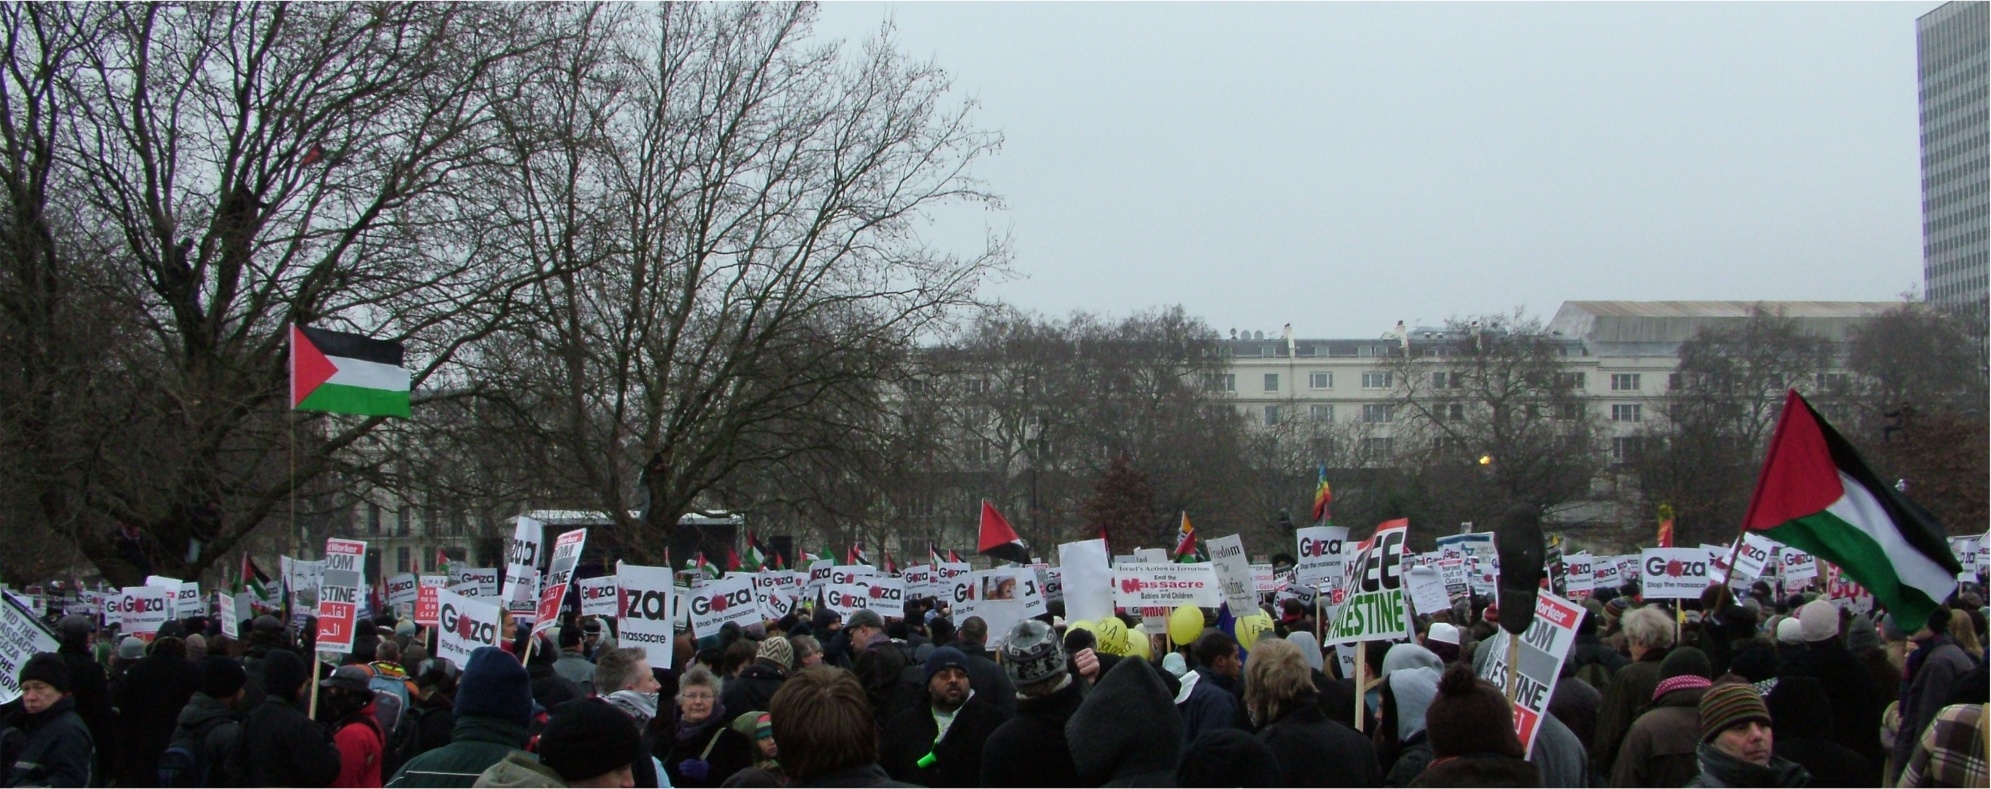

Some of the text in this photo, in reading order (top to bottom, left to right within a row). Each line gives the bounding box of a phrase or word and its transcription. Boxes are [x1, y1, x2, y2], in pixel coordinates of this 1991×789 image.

[321, 586, 357, 603] STINE
[1121, 578, 1204, 594] Massacre
[1141, 592, 1159, 600] Babies
[1172, 592, 1194, 600] Children
[2, 604, 38, 641] END THE
[696, 620, 711, 628] Stop
[724, 608, 756, 621] massacre
[0, 621, 38, 656] ASSACR
[621, 631, 666, 644] massacre
[1525, 616, 1558, 652] OM
